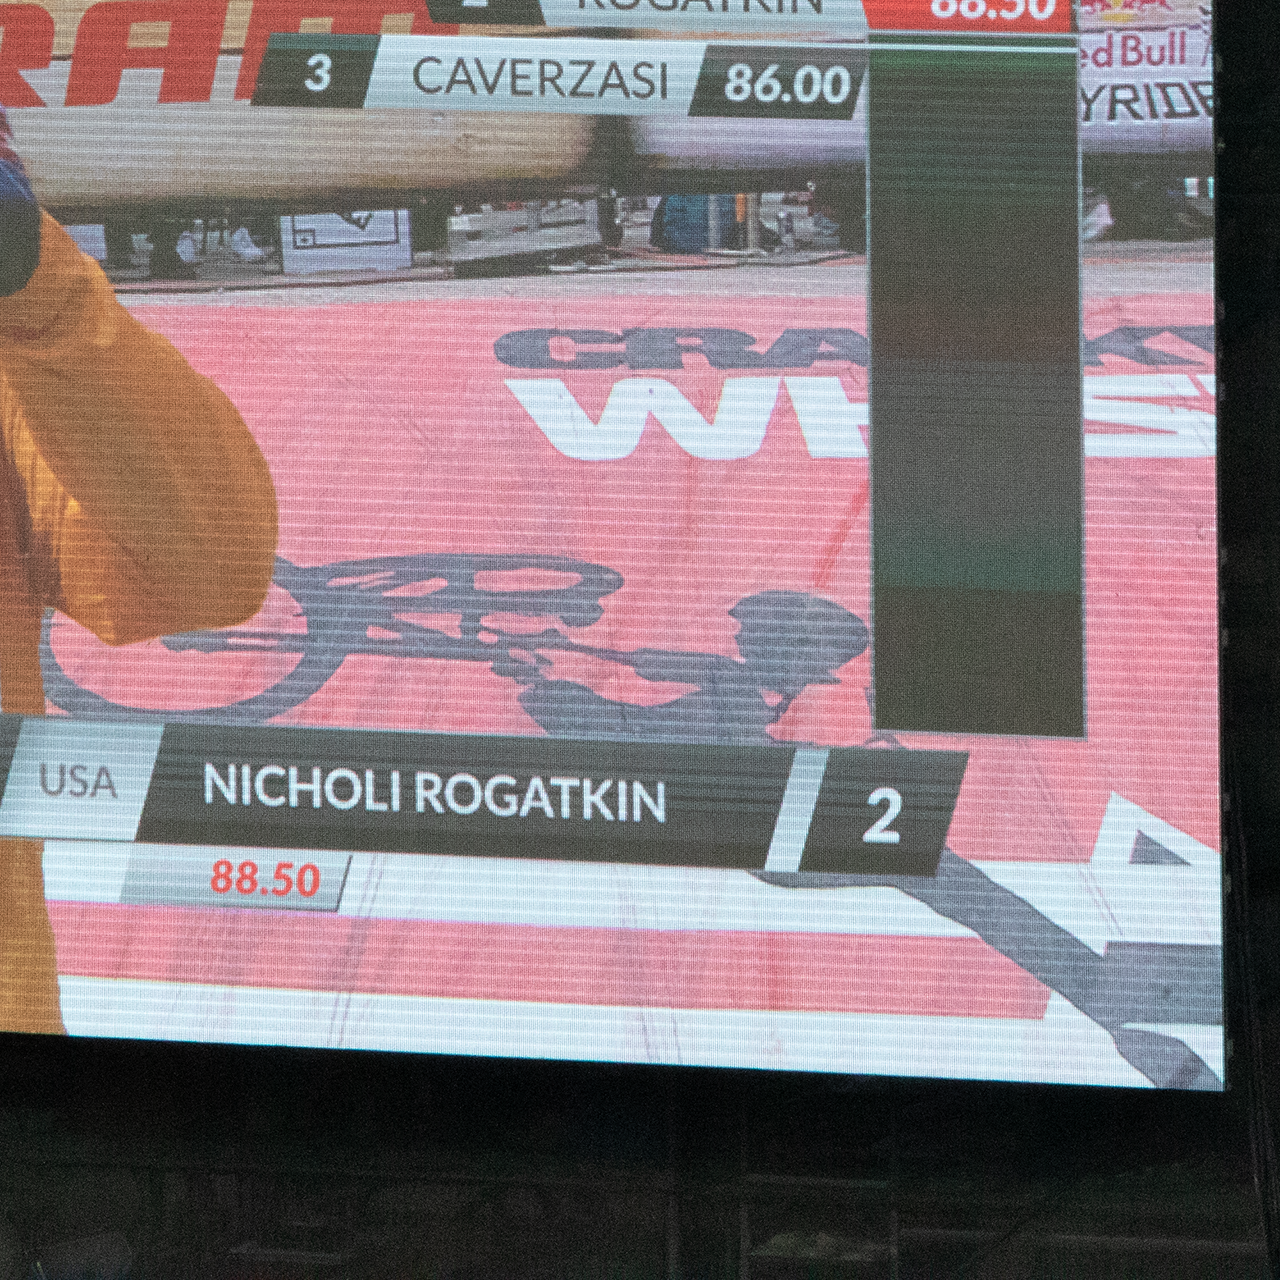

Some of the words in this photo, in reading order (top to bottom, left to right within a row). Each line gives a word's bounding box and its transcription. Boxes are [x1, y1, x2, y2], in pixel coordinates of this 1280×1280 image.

[1121, 31, 1186, 66] Bull
[304, 54, 331, 92] 3
[413, 56, 669, 99] CAVERZASI
[724, 65, 852, 103] 86.00
[1081, 82, 1213, 121] YRIDE
[38, 763, 119, 800] USA
[203, 763, 401, 813] NICHOLI
[416, 771, 667, 823] ROGATKIN
[862, 786, 902, 844] 2
[210, 860, 321, 898] 88.50
